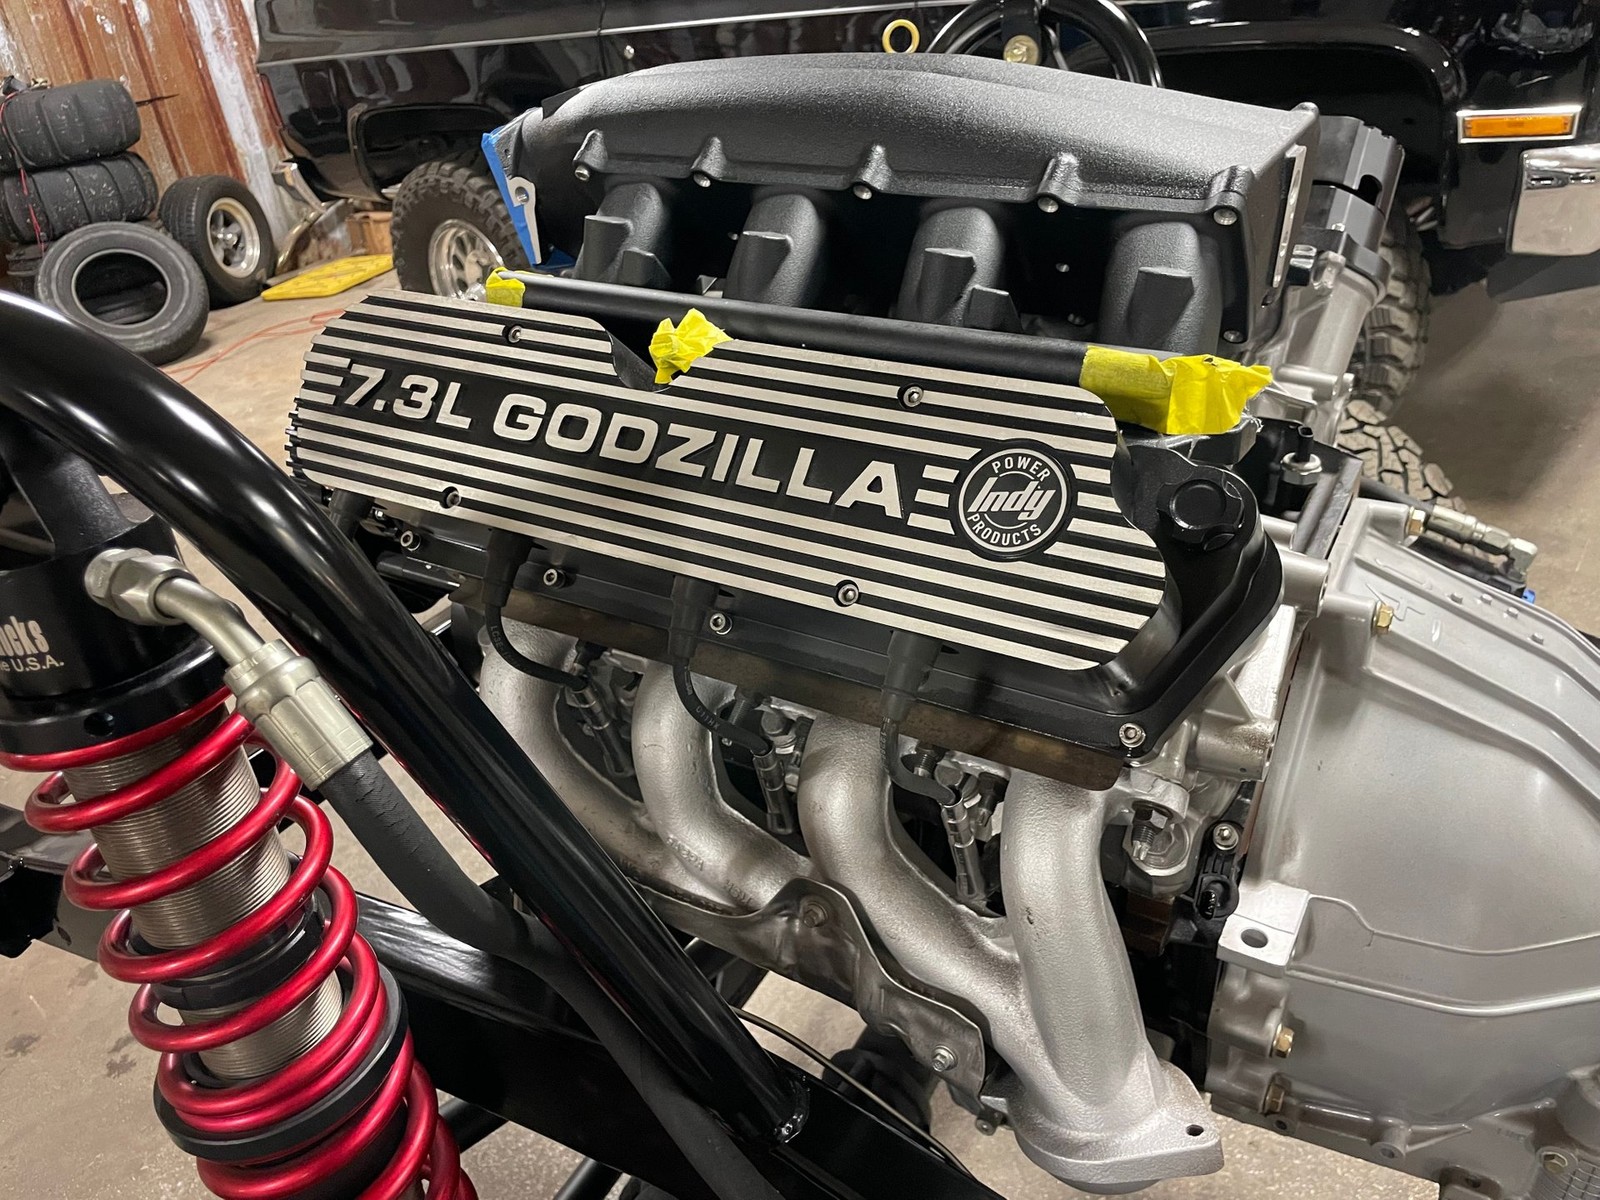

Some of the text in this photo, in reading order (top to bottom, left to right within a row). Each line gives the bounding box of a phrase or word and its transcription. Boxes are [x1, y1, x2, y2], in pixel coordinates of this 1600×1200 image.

[343, 361, 904, 519] 7.3L GODZILLA
[991, 456, 1051, 482] POWER
[967, 477, 1056, 520] Indy
[967, 513, 1042, 546] PRODUCTS
[0, 615, 49, 657] ocks
[10, 654, 65, 672] U.S.A.
